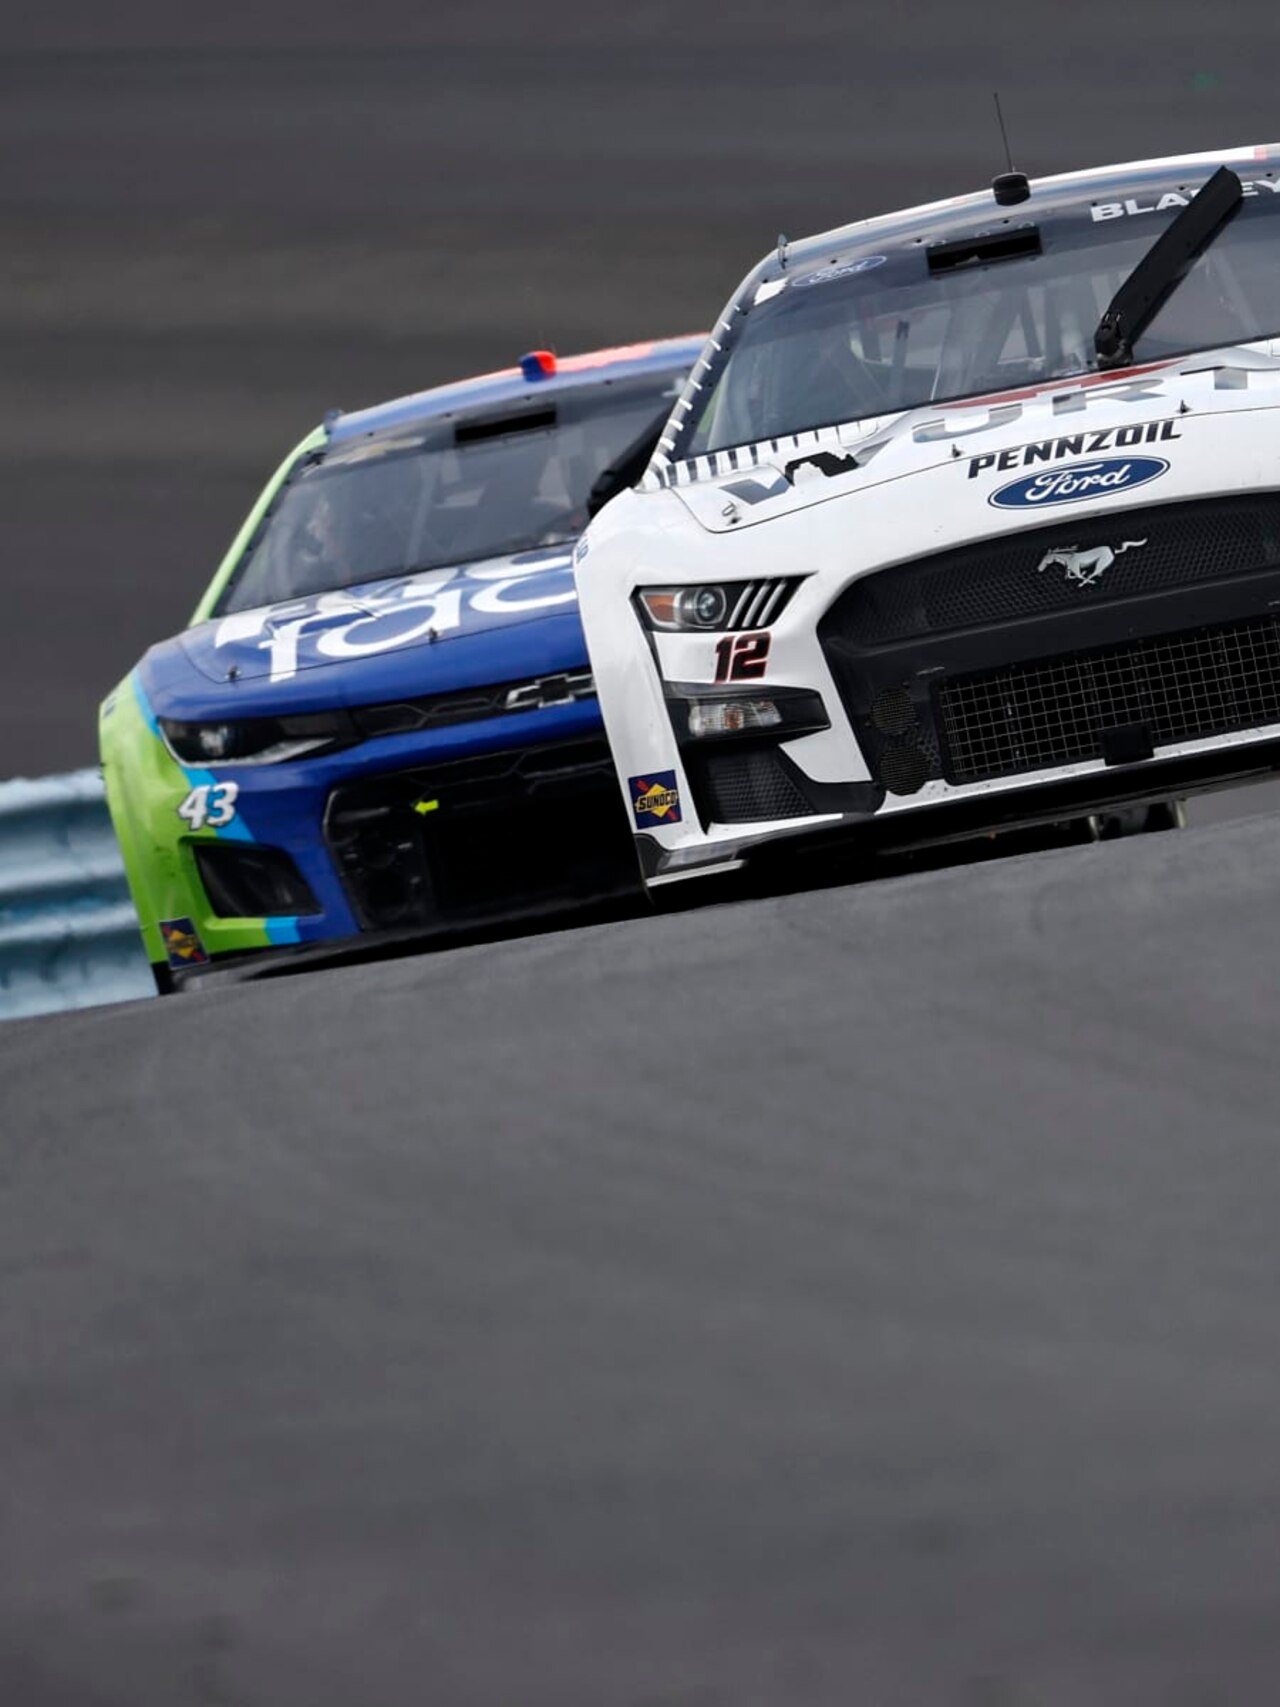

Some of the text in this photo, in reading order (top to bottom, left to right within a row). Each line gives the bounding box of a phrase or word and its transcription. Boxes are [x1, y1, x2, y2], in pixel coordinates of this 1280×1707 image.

[967, 420, 1183, 480] PENNZOIL
[1024, 463, 1132, 502] Ford
[714, 630, 772, 685] 12
[177, 780, 240, 831] 43
[634, 789, 679, 813] SUNOCO
